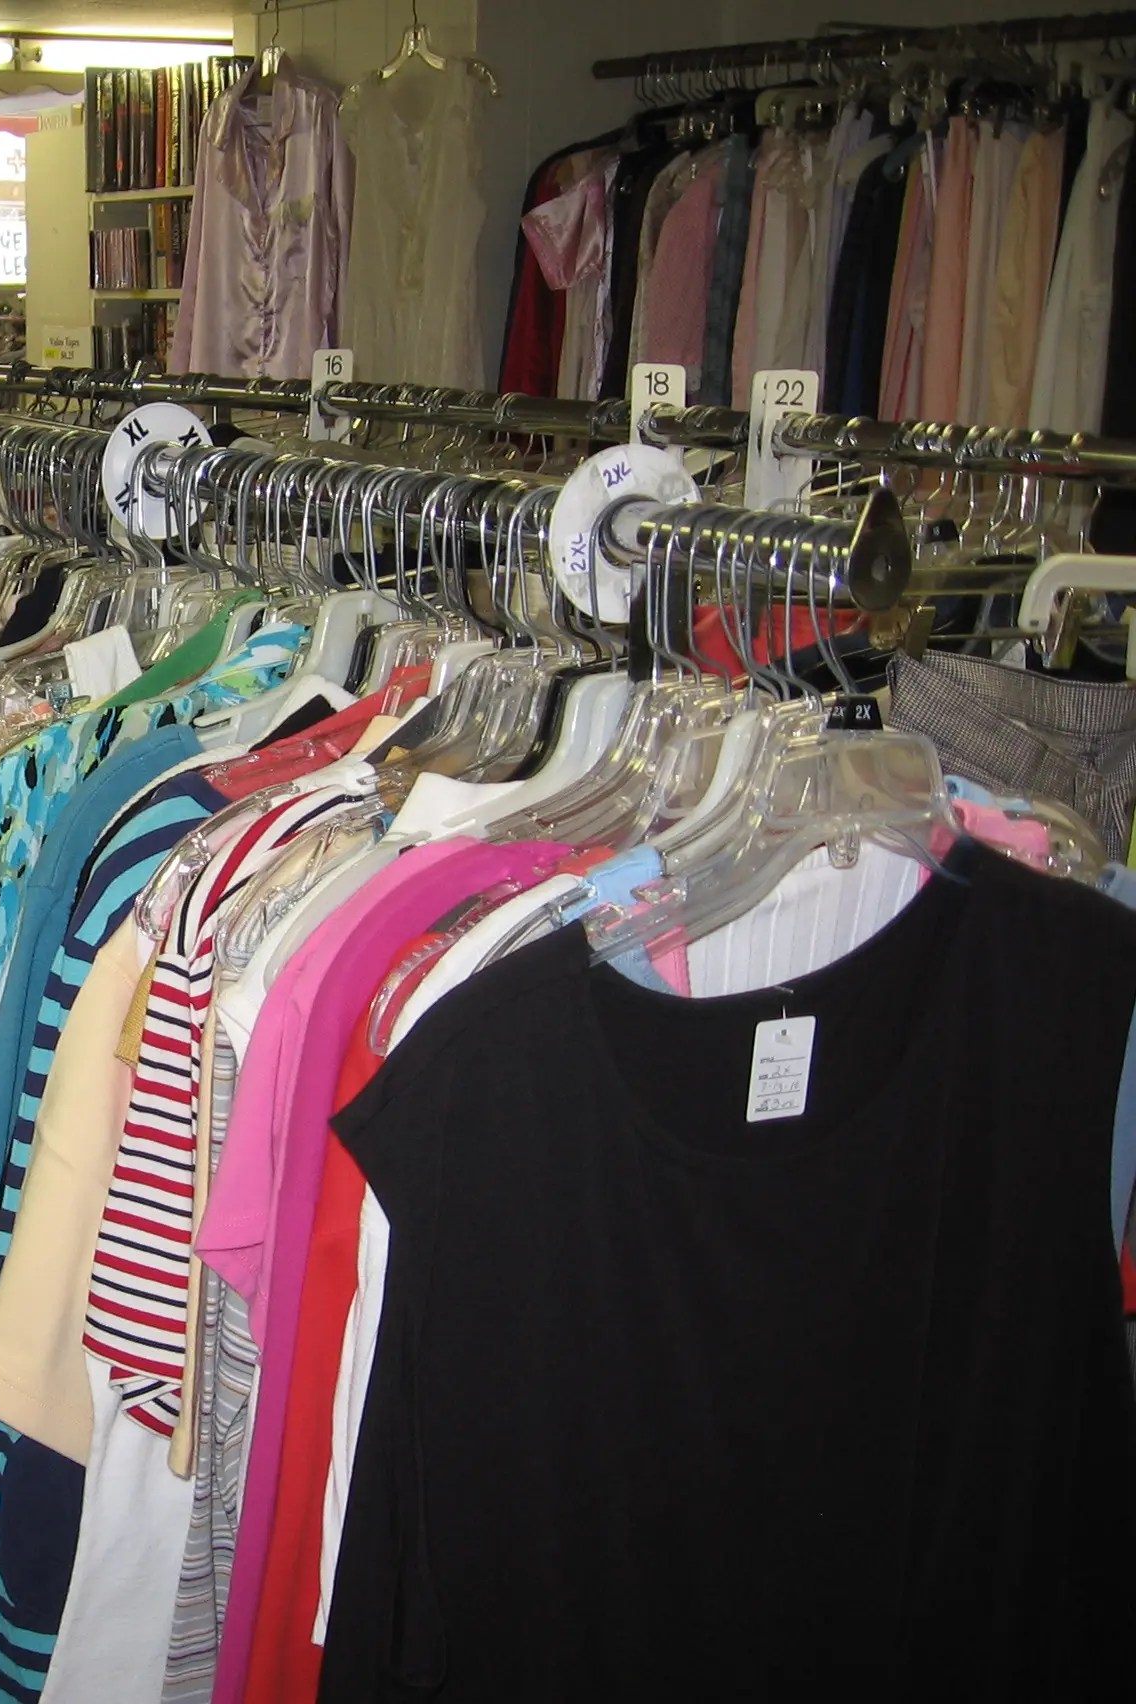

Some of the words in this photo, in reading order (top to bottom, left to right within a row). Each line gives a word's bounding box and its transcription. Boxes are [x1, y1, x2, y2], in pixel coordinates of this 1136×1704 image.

[324, 355, 343, 376] 16
[644, 371, 669, 396] 18
[775, 379, 805, 406] 22
[122, 417, 149, 447] XL
[602, 461, 632, 489] 2XL
[570, 533, 588, 573] 2XL
[855, 704, 872, 720] 2X
